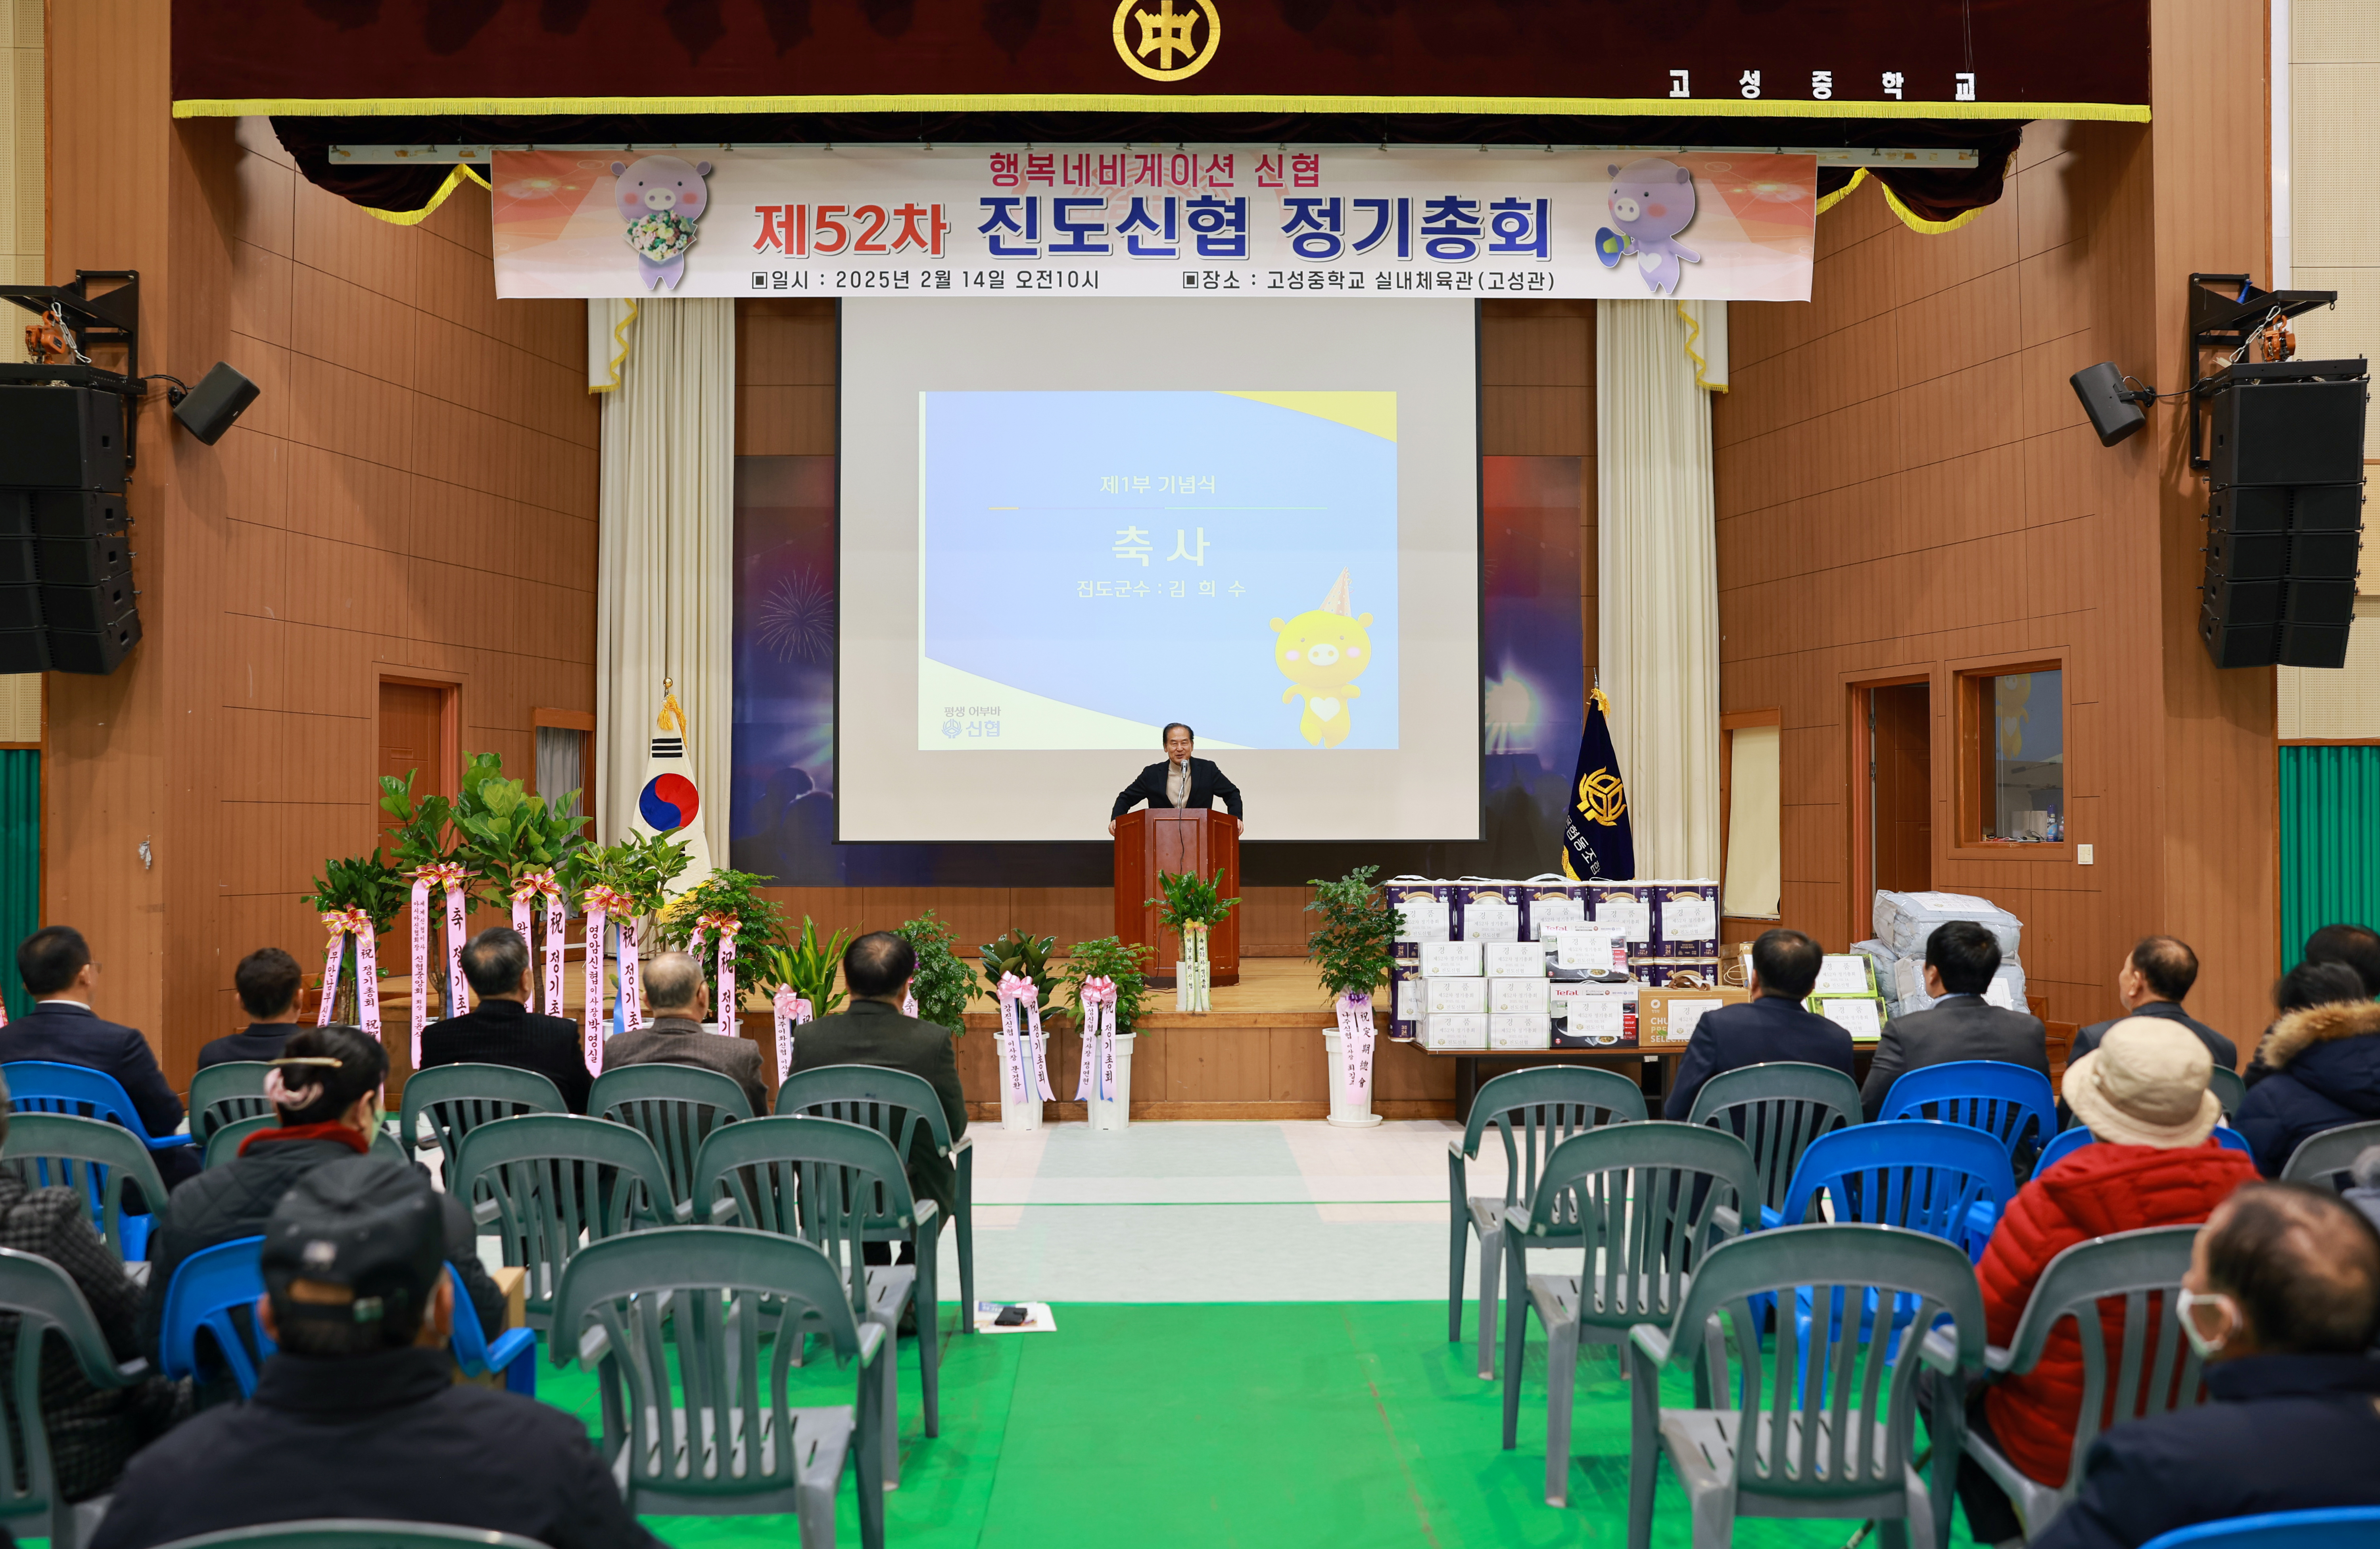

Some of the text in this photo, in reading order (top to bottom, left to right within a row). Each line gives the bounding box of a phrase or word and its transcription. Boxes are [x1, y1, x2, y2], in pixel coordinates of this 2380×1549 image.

[990, 152, 1319, 188] 행복네비게이션 신협
[753, 194, 1549, 260] 제52차 진도신협 정기총회
[772, 271, 809, 290] 일시
[836, 270, 909, 290] 2025년
[921, 270, 951, 289] 2월
[962, 271, 1004, 290] 14일
[1016, 270, 1098, 290] 오전10시
[1202, 271, 1240, 290] 장소
[1267, 271, 1365, 290] 고성중학교
[1375, 271, 1554, 290] 실내체육관(고성관)
[1100, 475, 1216, 494] 제1부 기념식
[1077, 580, 1151, 598] 진도군수
[944, 706, 1001, 717] 평생 어부바
[965, 720, 1000, 737] 신협
[451, 907, 463, 931] 축
[361, 965, 375, 1008] 정기총회
[414, 955, 425, 995] 신협중앙회
[904, 999, 914, 1014] 축
[1004, 1004, 1014, 1036] 강진신협
[1342, 1012, 1352, 1040] 나주신협
[1008, 1040, 1017, 1061] 이사장
[1033, 1023, 1045, 1084] 정기총회
[1105, 1023, 1113, 1084] 정기총회
